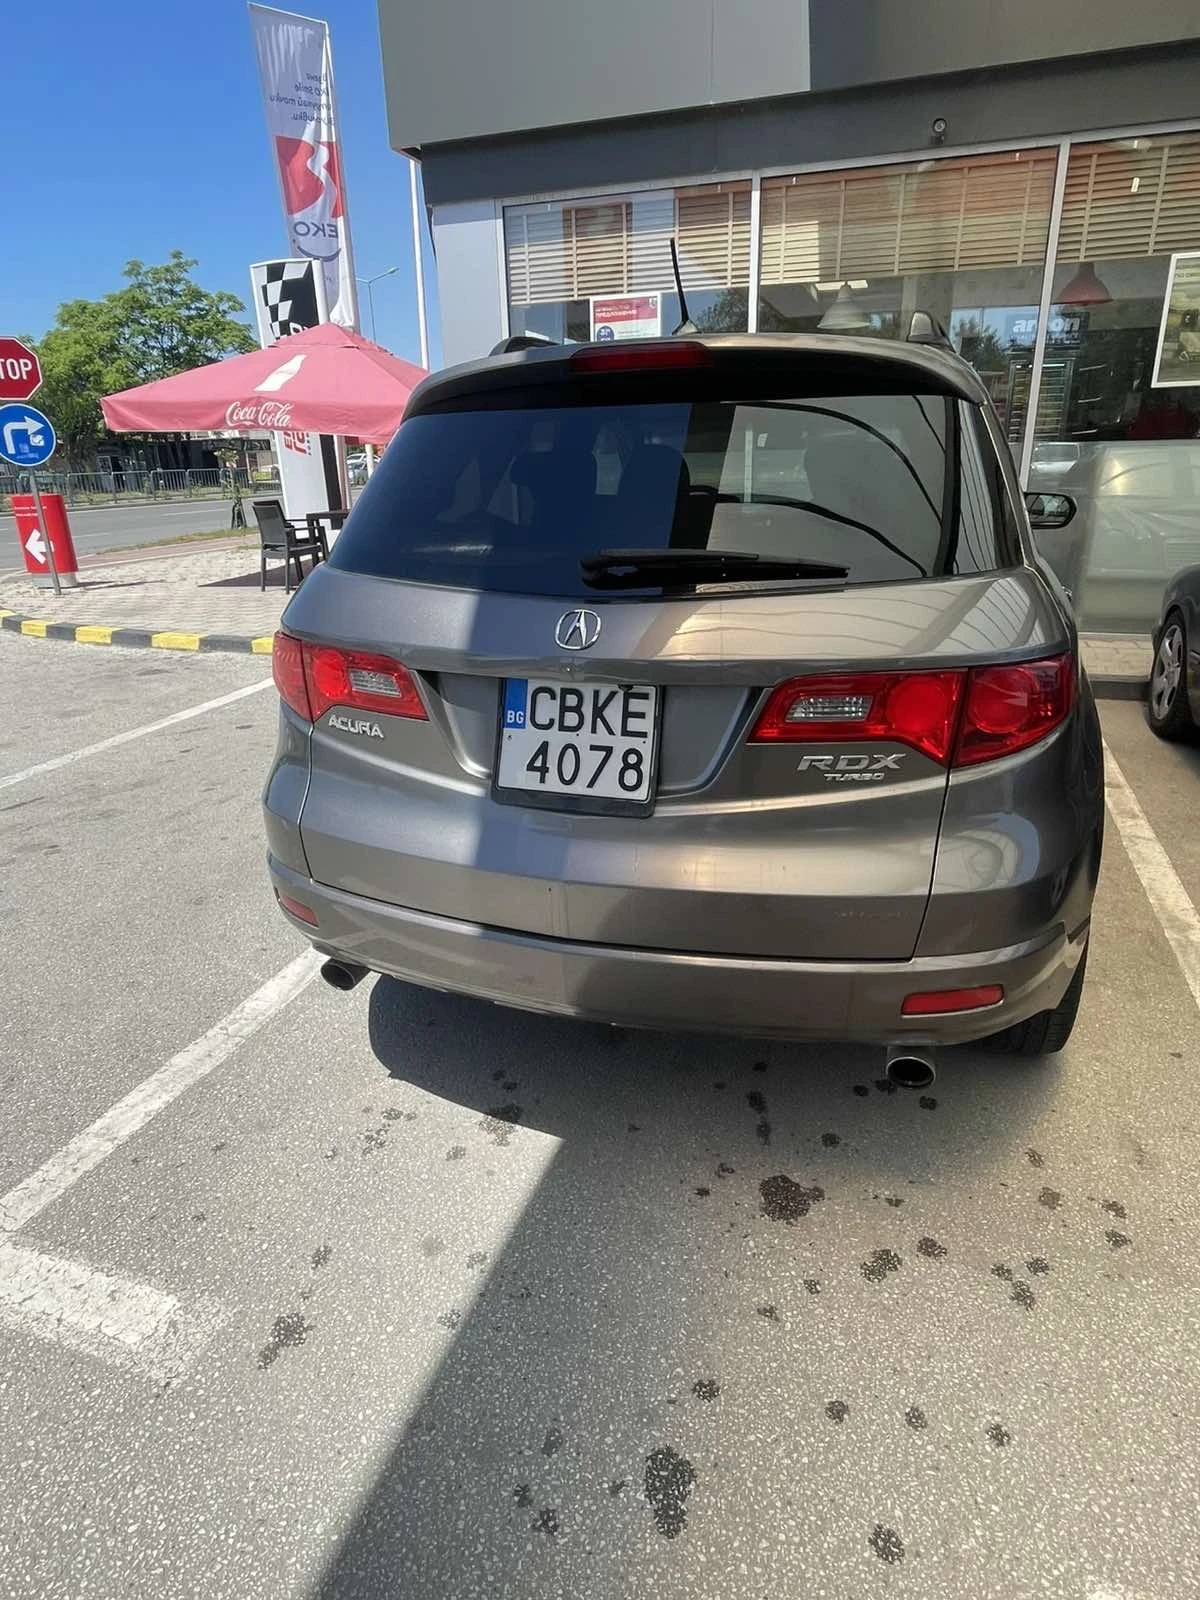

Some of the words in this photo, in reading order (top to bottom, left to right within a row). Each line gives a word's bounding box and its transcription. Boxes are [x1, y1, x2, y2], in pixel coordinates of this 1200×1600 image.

[0, 358, 32, 380] TOP
[507, 710, 525, 725] BG
[529, 685, 650, 739] CBKE
[328, 713, 385, 740] ACURA
[525, 740, 645, 793] 4078
[797, 753, 906, 771] RDX
[823, 773, 885, 781] TURBO
